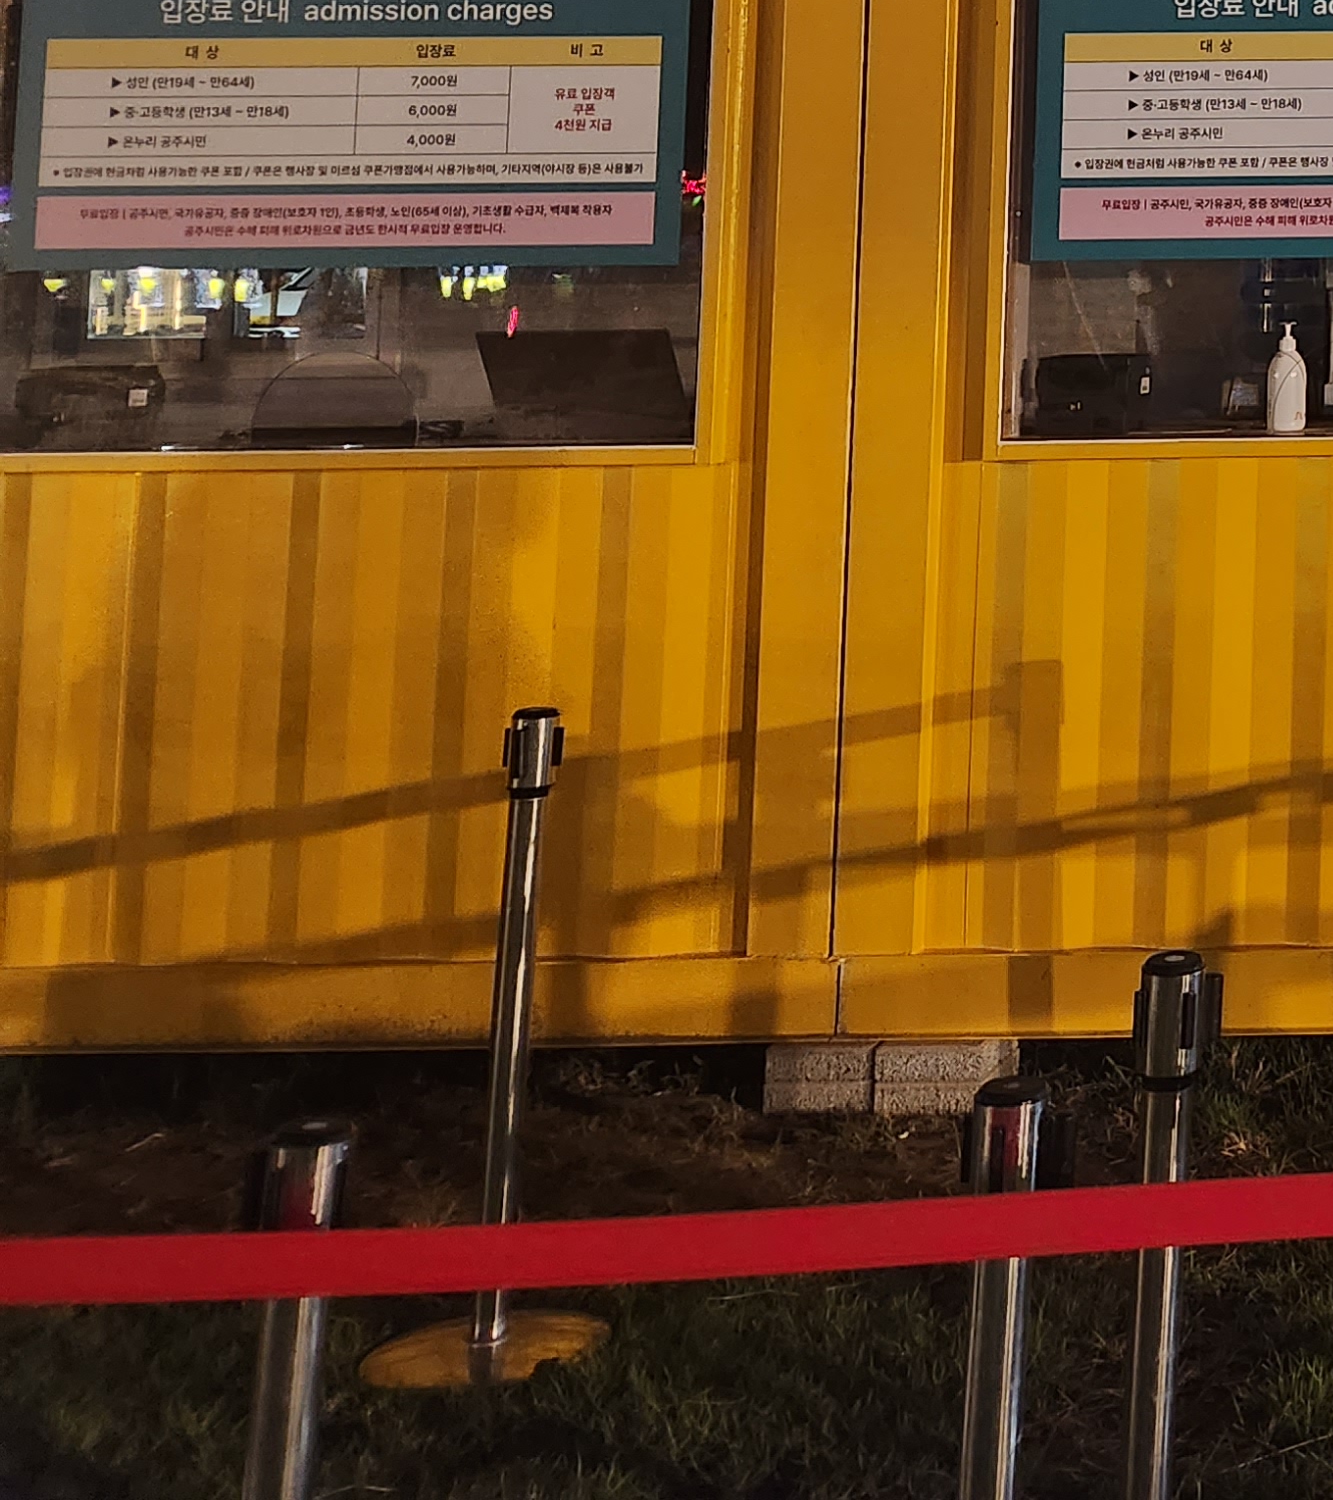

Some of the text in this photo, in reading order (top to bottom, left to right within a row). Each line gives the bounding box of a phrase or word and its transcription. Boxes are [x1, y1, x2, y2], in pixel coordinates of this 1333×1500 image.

[415, 42, 456, 59] 입장료
[410, 73, 458, 89] 7,000원
[1142, 68, 1165, 82] 성인
[1167, 68, 1210, 84] (만19세
[1223, 67, 1268, 83] 만64세)
[553, 86, 615, 101] 유료 입장객
[407, 103, 457, 119] 6,000원
[572, 102, 595, 116] 쿠폰
[1204, 97, 1246, 113] (만13세
[1260, 96, 1302, 112] 만18세)
[553, 117, 612, 132] 4천원 지급
[405, 132, 456, 148] 4,000원
[1140, 126, 1223, 141] 온누리 공주시민
